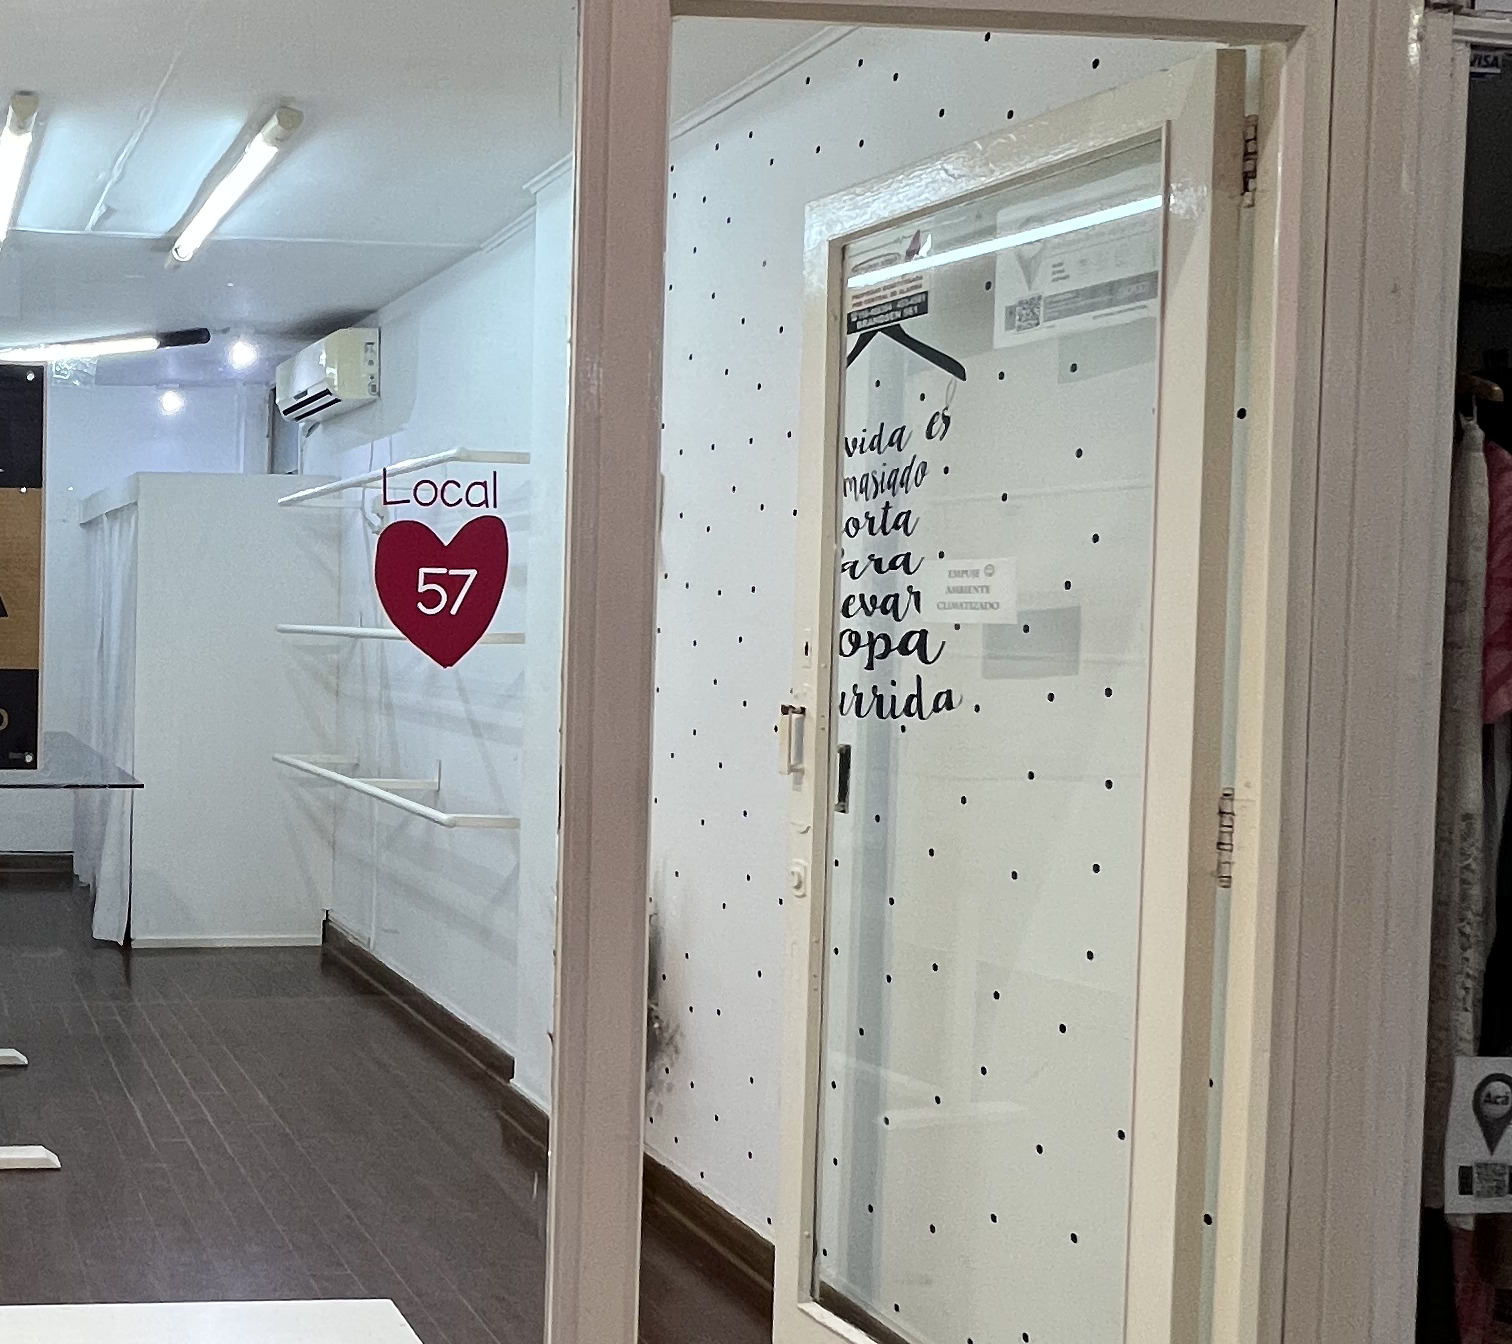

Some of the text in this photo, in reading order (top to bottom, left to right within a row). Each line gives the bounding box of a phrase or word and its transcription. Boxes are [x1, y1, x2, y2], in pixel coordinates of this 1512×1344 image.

[844, 406, 951, 458] vida es
[382, 467, 498, 509] Local
[842, 453, 930, 503] masiado
[843, 500, 921, 539] orta
[840, 549, 925, 581] ara
[416, 567, 478, 616] 57
[840, 584, 922, 623] evar
[838, 628, 947, 671] opa
[839, 673, 964, 721] rrida
